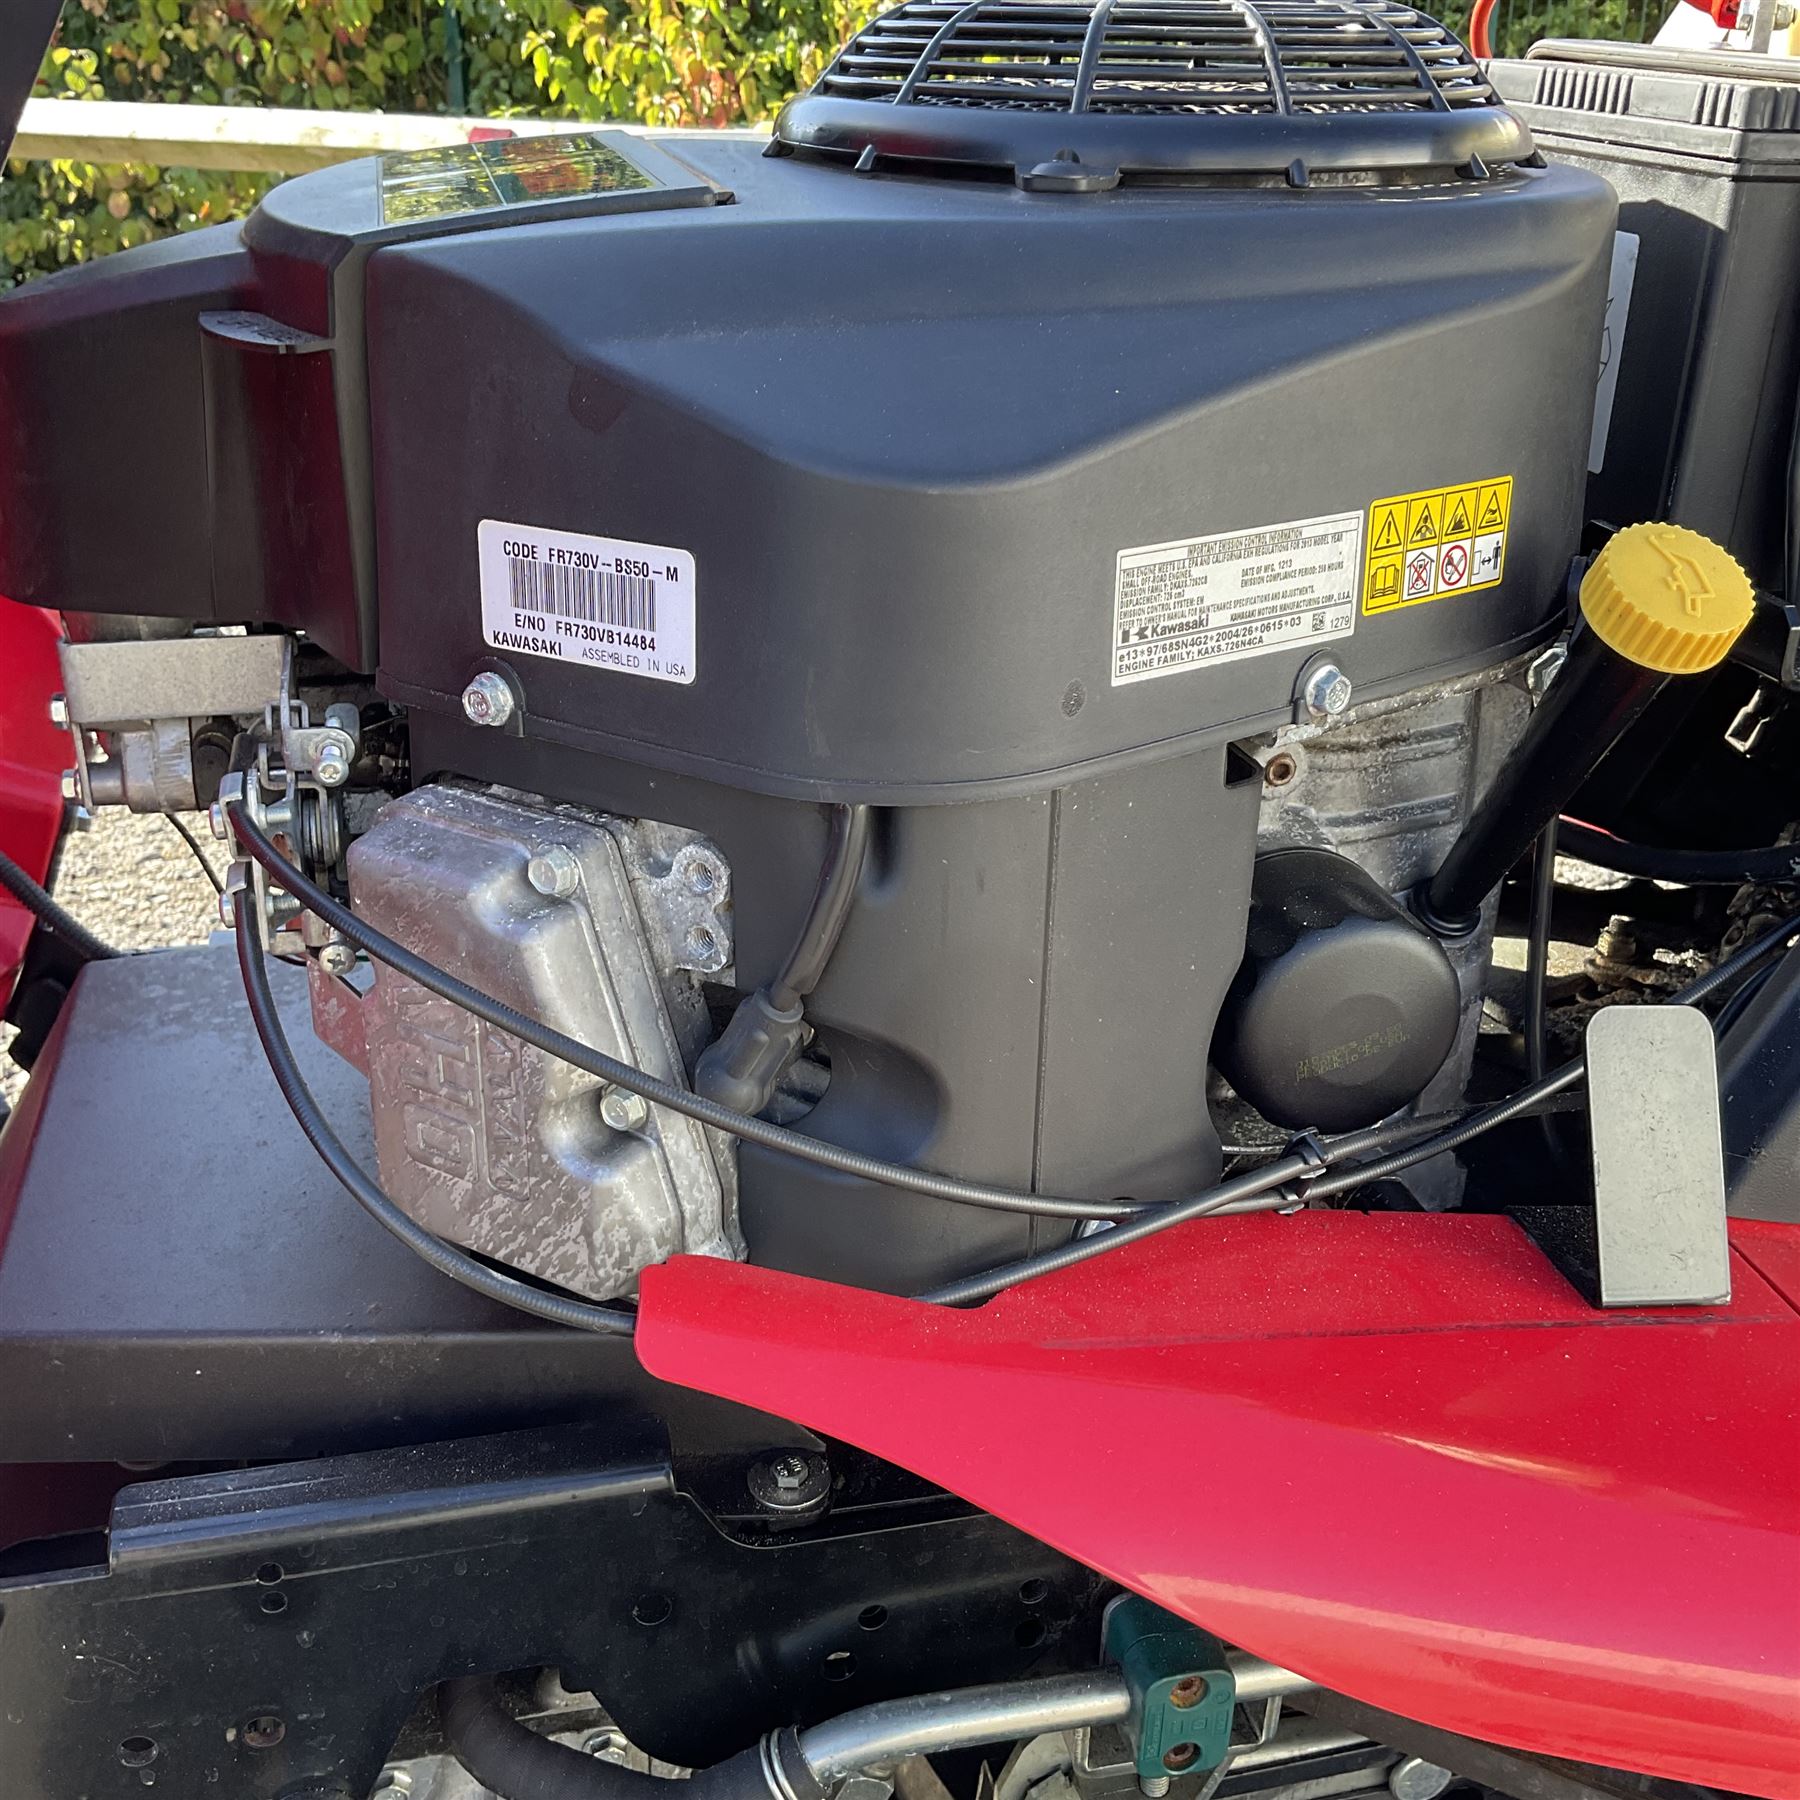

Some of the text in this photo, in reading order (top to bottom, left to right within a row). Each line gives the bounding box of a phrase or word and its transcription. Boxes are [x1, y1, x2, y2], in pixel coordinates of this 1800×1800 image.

[503, 540, 538, 560] CODE
[1122, 569, 1134, 579] THIS
[1136, 565, 1156, 577] ENGINE
[1158, 562, 1175, 573] MEETS
[1212, 551, 1241, 564] CALIFORNIA
[1255, 543, 1288, 556] REGULATIONS
[1290, 541, 1299, 550] FOR
[1331, 533, 1342, 543] YEAR
[1241, 575, 1264, 587] EMISSION
[1266, 569, 1296, 582] COMPLIANCE
[1327, 560, 1343, 571] HOURS
[1242, 567, 1254, 577] DATE
[1255, 565, 1262, 574] OF
[1278, 558, 1292, 569] 1213
[1120, 587, 1145, 599] EMISSION
[1122, 578, 1139, 589] SMALL
[1119, 606, 1144, 619] EMISSION
[1146, 601, 1171, 614] CONTROL
[1166, 609, 1186, 621] MANUAL
[1188, 607, 1197, 617] FOR
[1198, 600, 1232, 615] MAINTENANCE
[1257, 604, 1277, 616] MOTORS
[1279, 596, 1319, 612] MANUFACTURING
[514, 613, 656, 651] E/NO FR730VB14484
[1151, 614, 1208, 638] Kawasaki
[1330, 616, 1350, 629] 1279
[493, 630, 562, 656] KAWASAKI
[582, 648, 686, 677] ASSEMBLED IN USA
[1119, 658, 1154, 674] ENGINE
